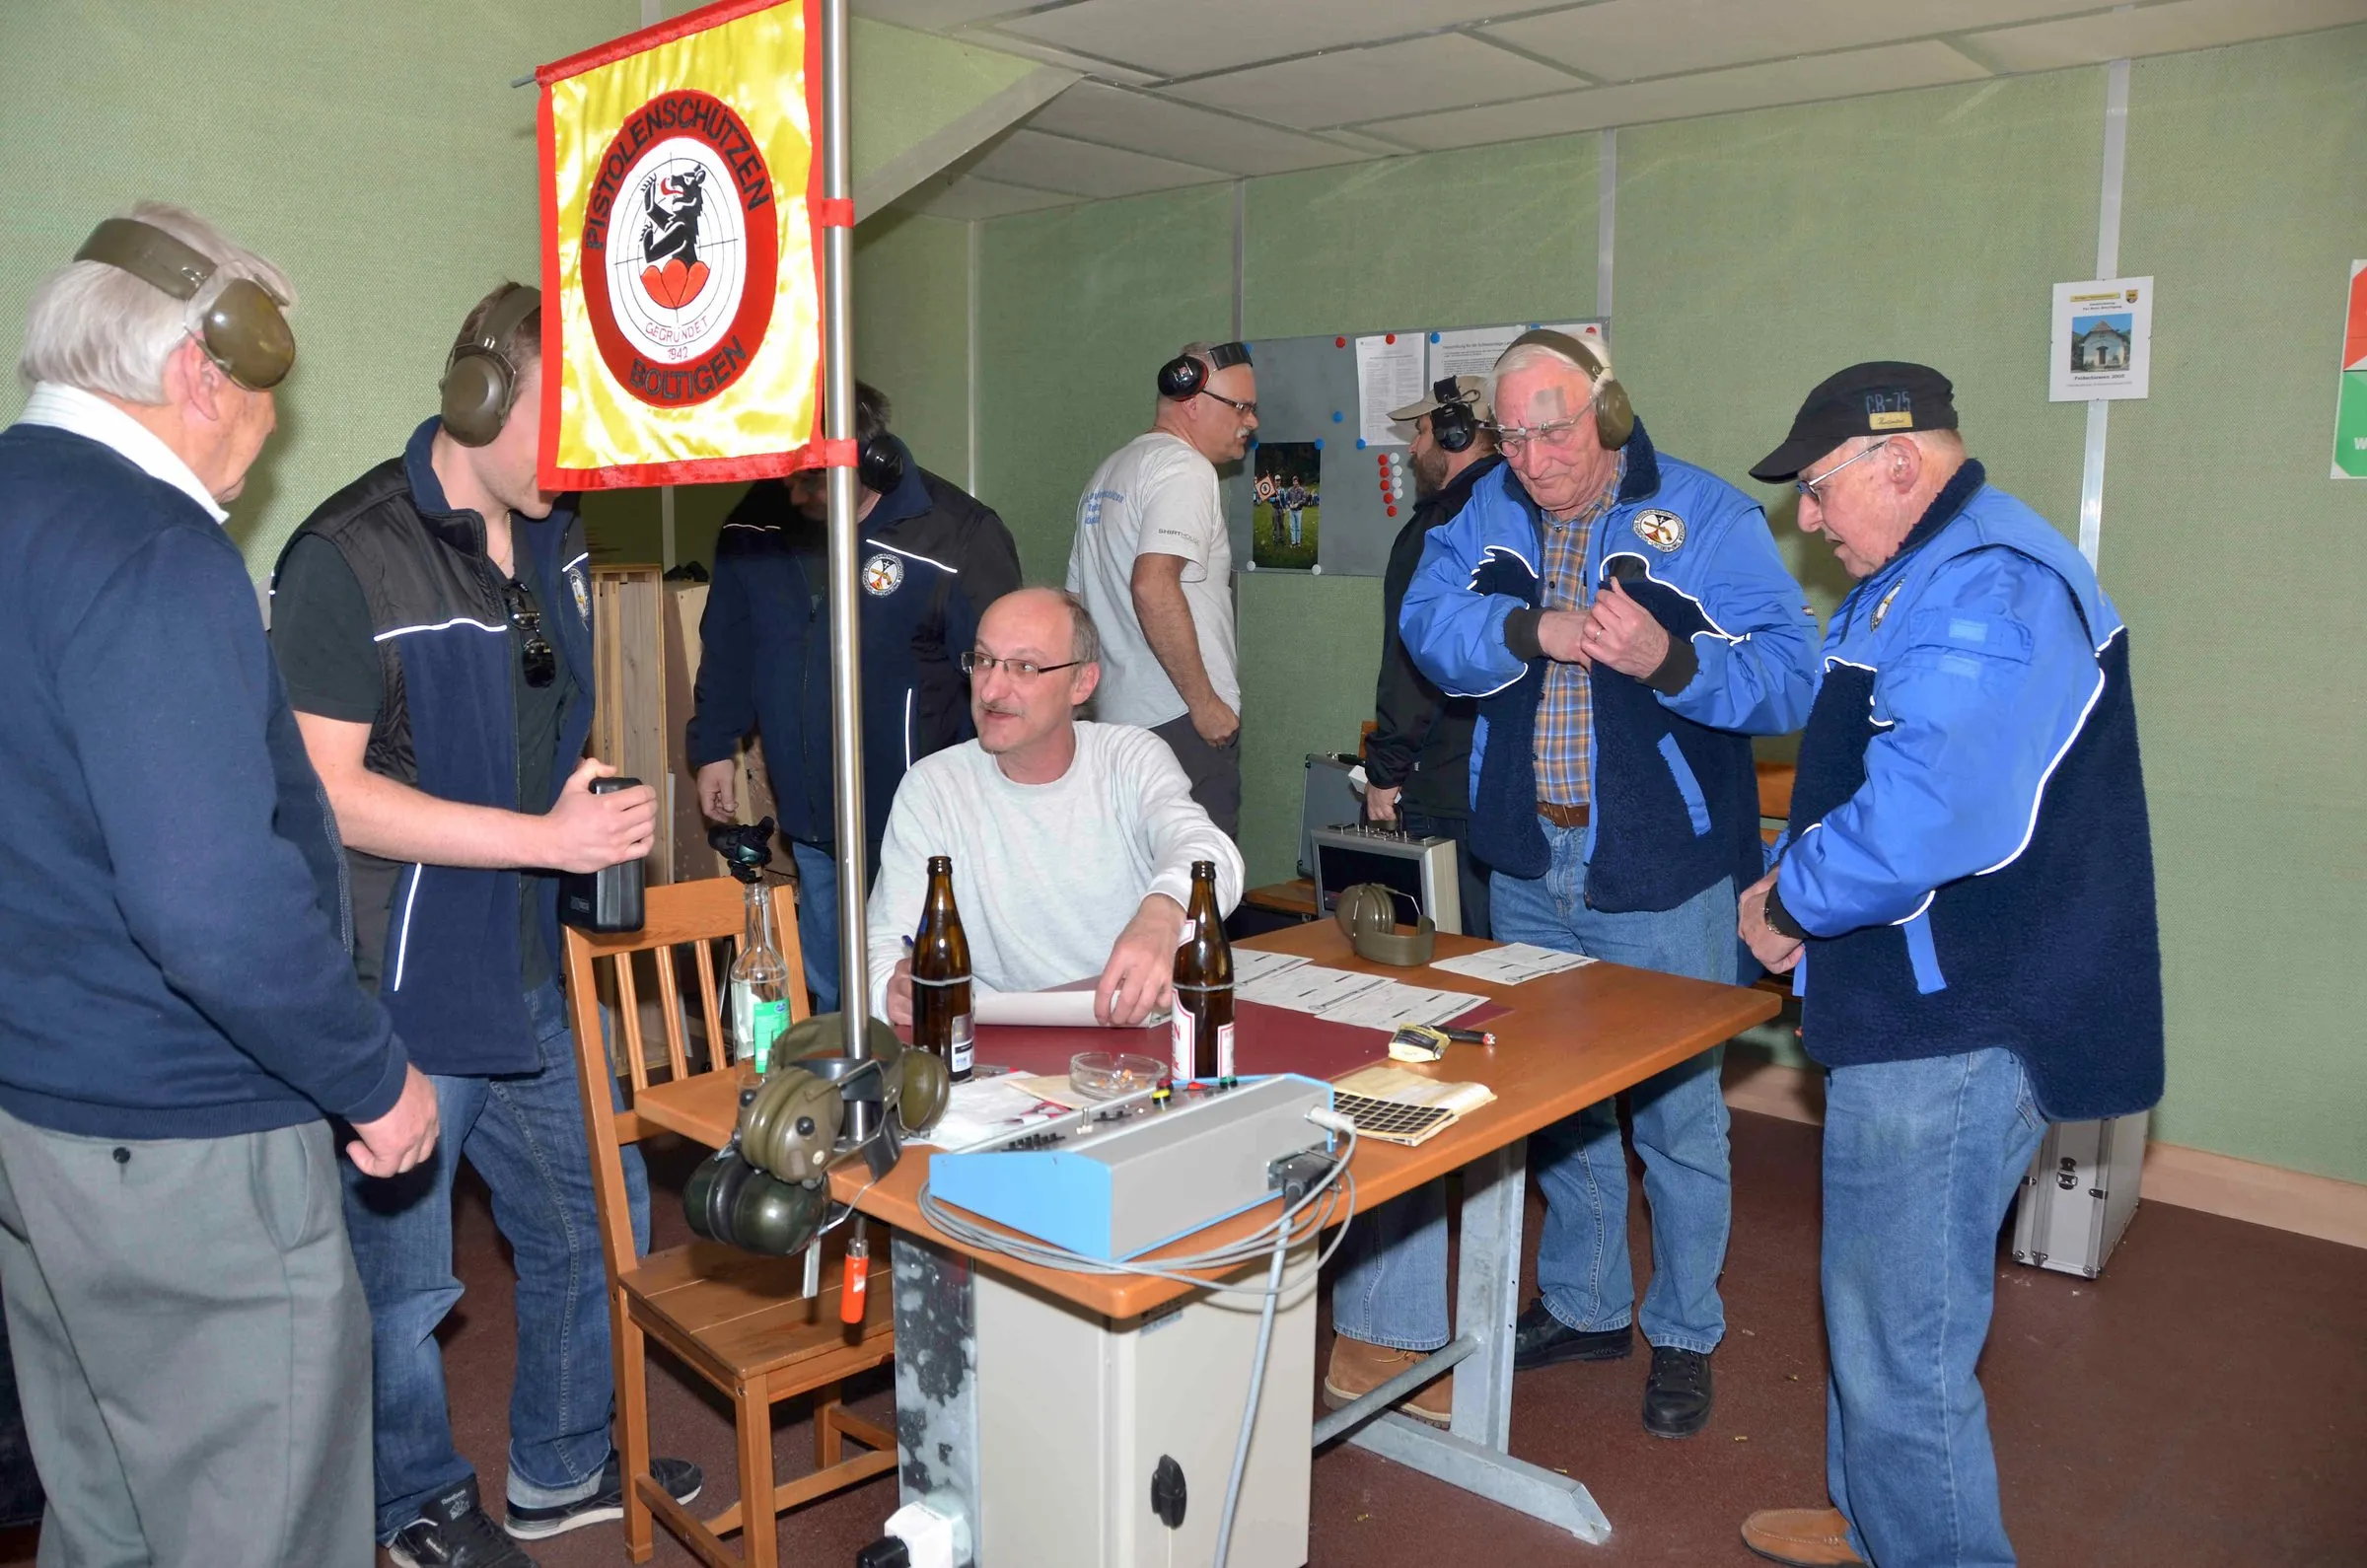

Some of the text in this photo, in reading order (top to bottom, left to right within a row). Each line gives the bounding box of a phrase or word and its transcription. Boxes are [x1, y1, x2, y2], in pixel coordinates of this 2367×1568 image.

[586, 97, 770, 250] PISTOLENSCHÜTZEN
[629, 334, 748, 399] BOLTIGEN
[667, 346, 688, 361] 1942
